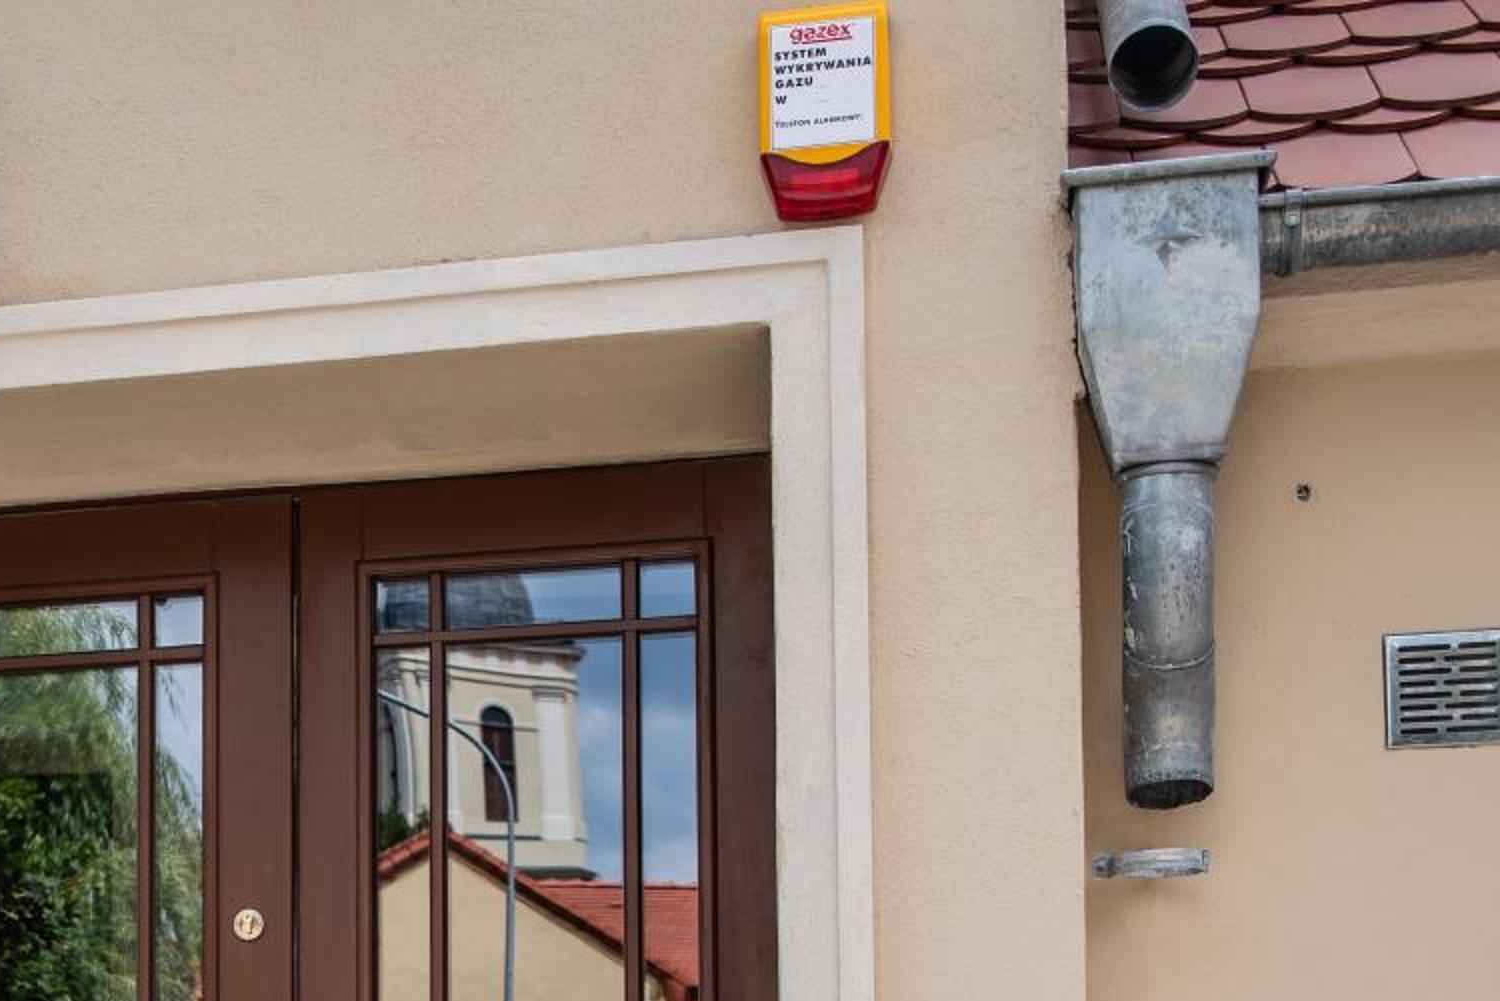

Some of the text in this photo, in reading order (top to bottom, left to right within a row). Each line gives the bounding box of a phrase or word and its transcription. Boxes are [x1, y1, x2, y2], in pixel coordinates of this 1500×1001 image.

[789, 23, 852, 44] gazex
[774, 47, 827, 61] SYSTEM
[774, 56, 871, 75] WYKRYWANIA
[775, 76, 813, 89] GAZU
[775, 95, 787, 105] W
